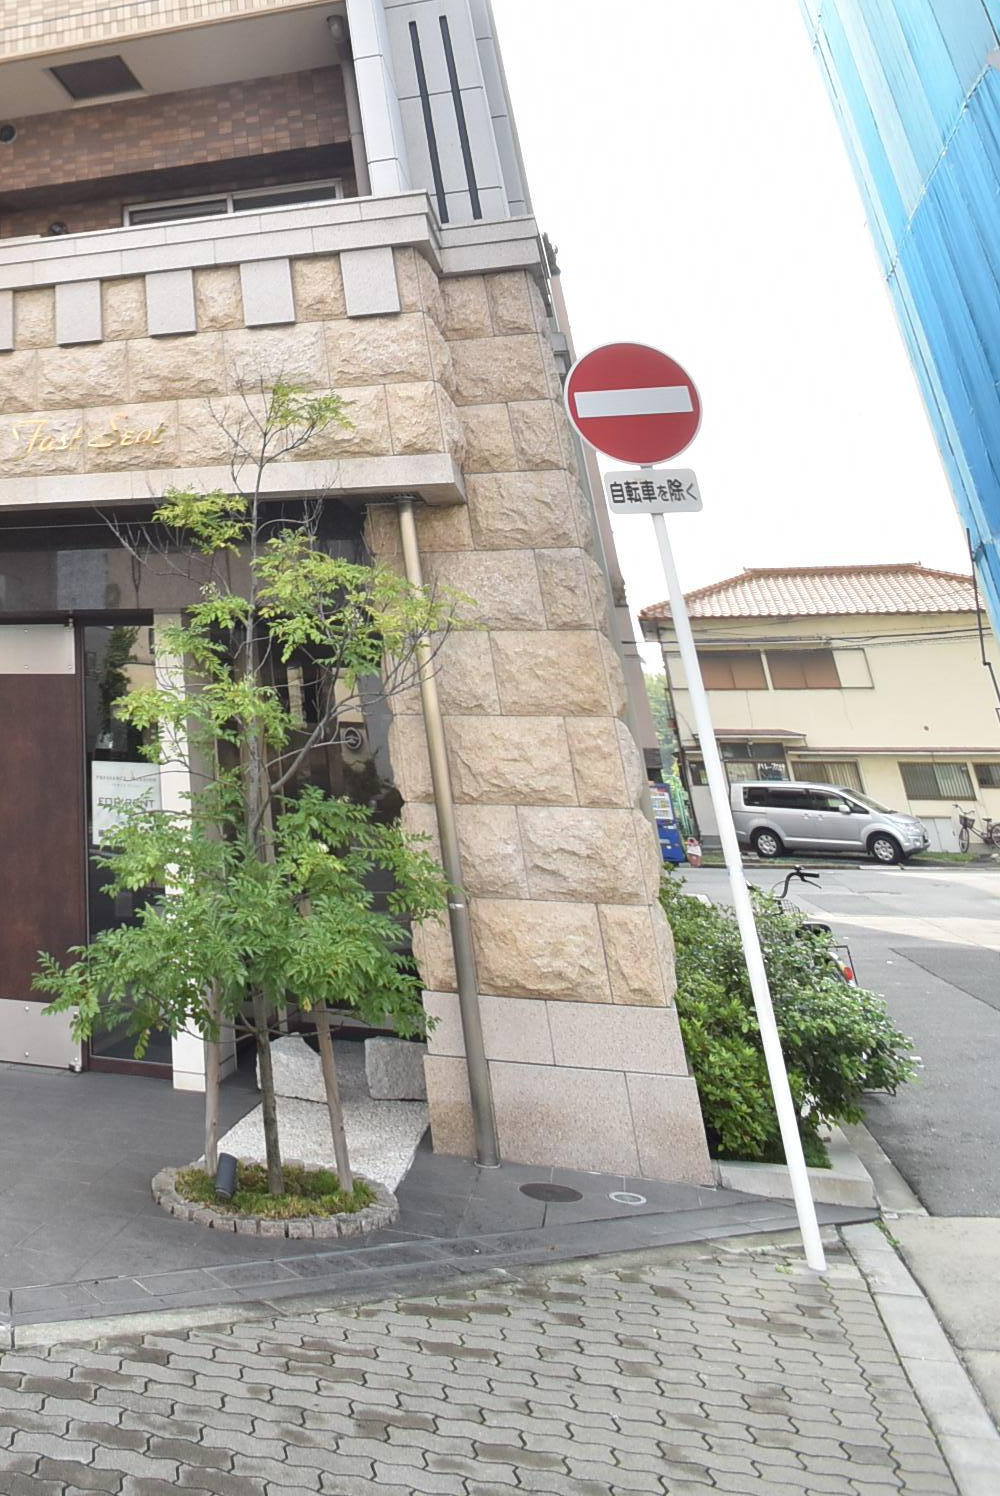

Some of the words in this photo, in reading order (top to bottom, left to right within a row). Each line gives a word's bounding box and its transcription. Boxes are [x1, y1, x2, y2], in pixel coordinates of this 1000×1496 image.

[87, 411, 170, 448] Seat
[610, 479, 697, 503] 自転車を除く
